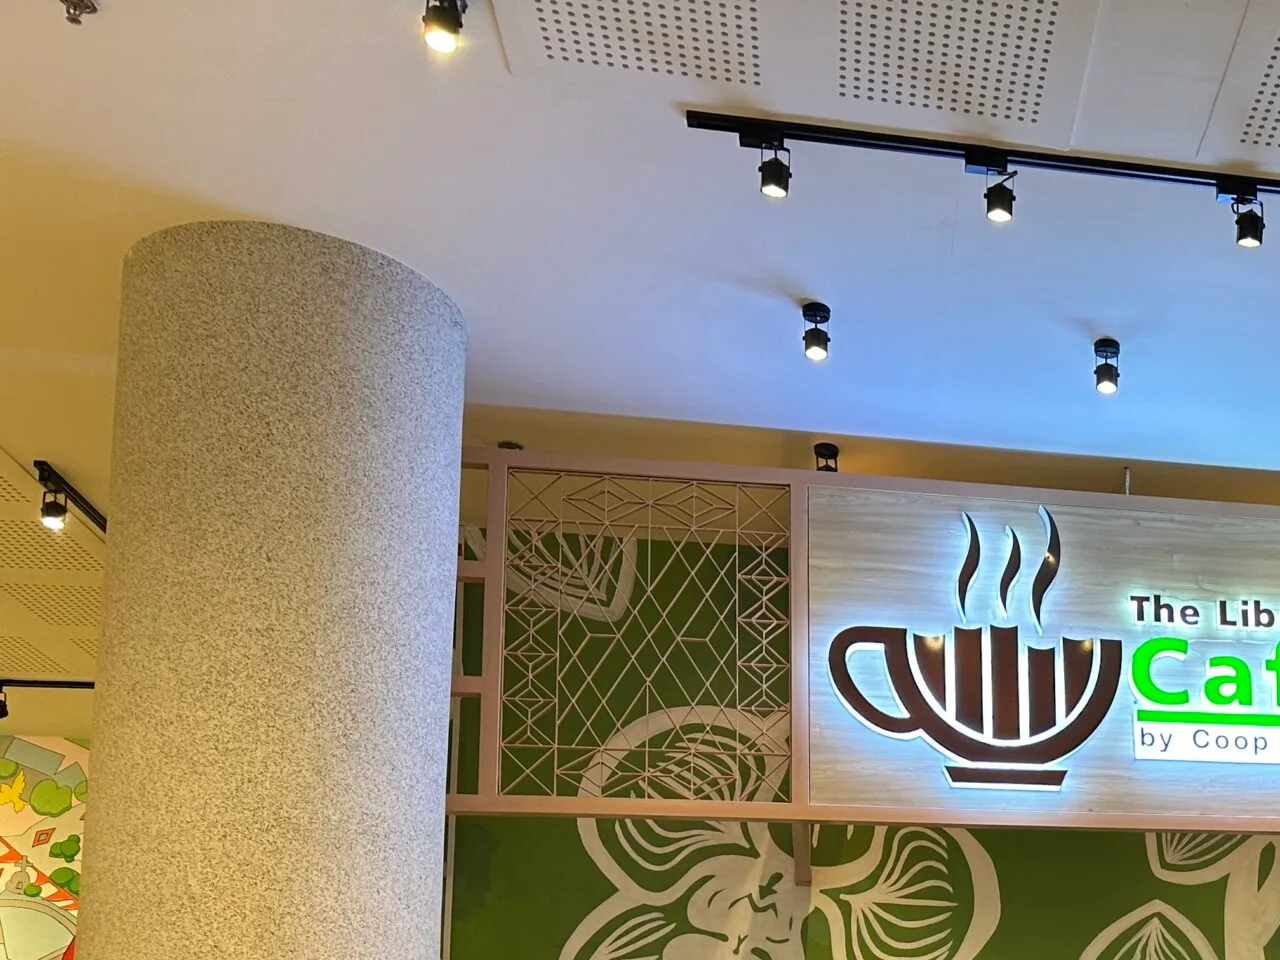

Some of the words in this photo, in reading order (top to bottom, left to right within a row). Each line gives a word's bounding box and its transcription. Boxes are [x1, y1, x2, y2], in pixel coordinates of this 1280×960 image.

[1130, 594, 1200, 626] The
[1140, 727, 1173, 752] by
[1192, 729, 1268, 755] Coop
